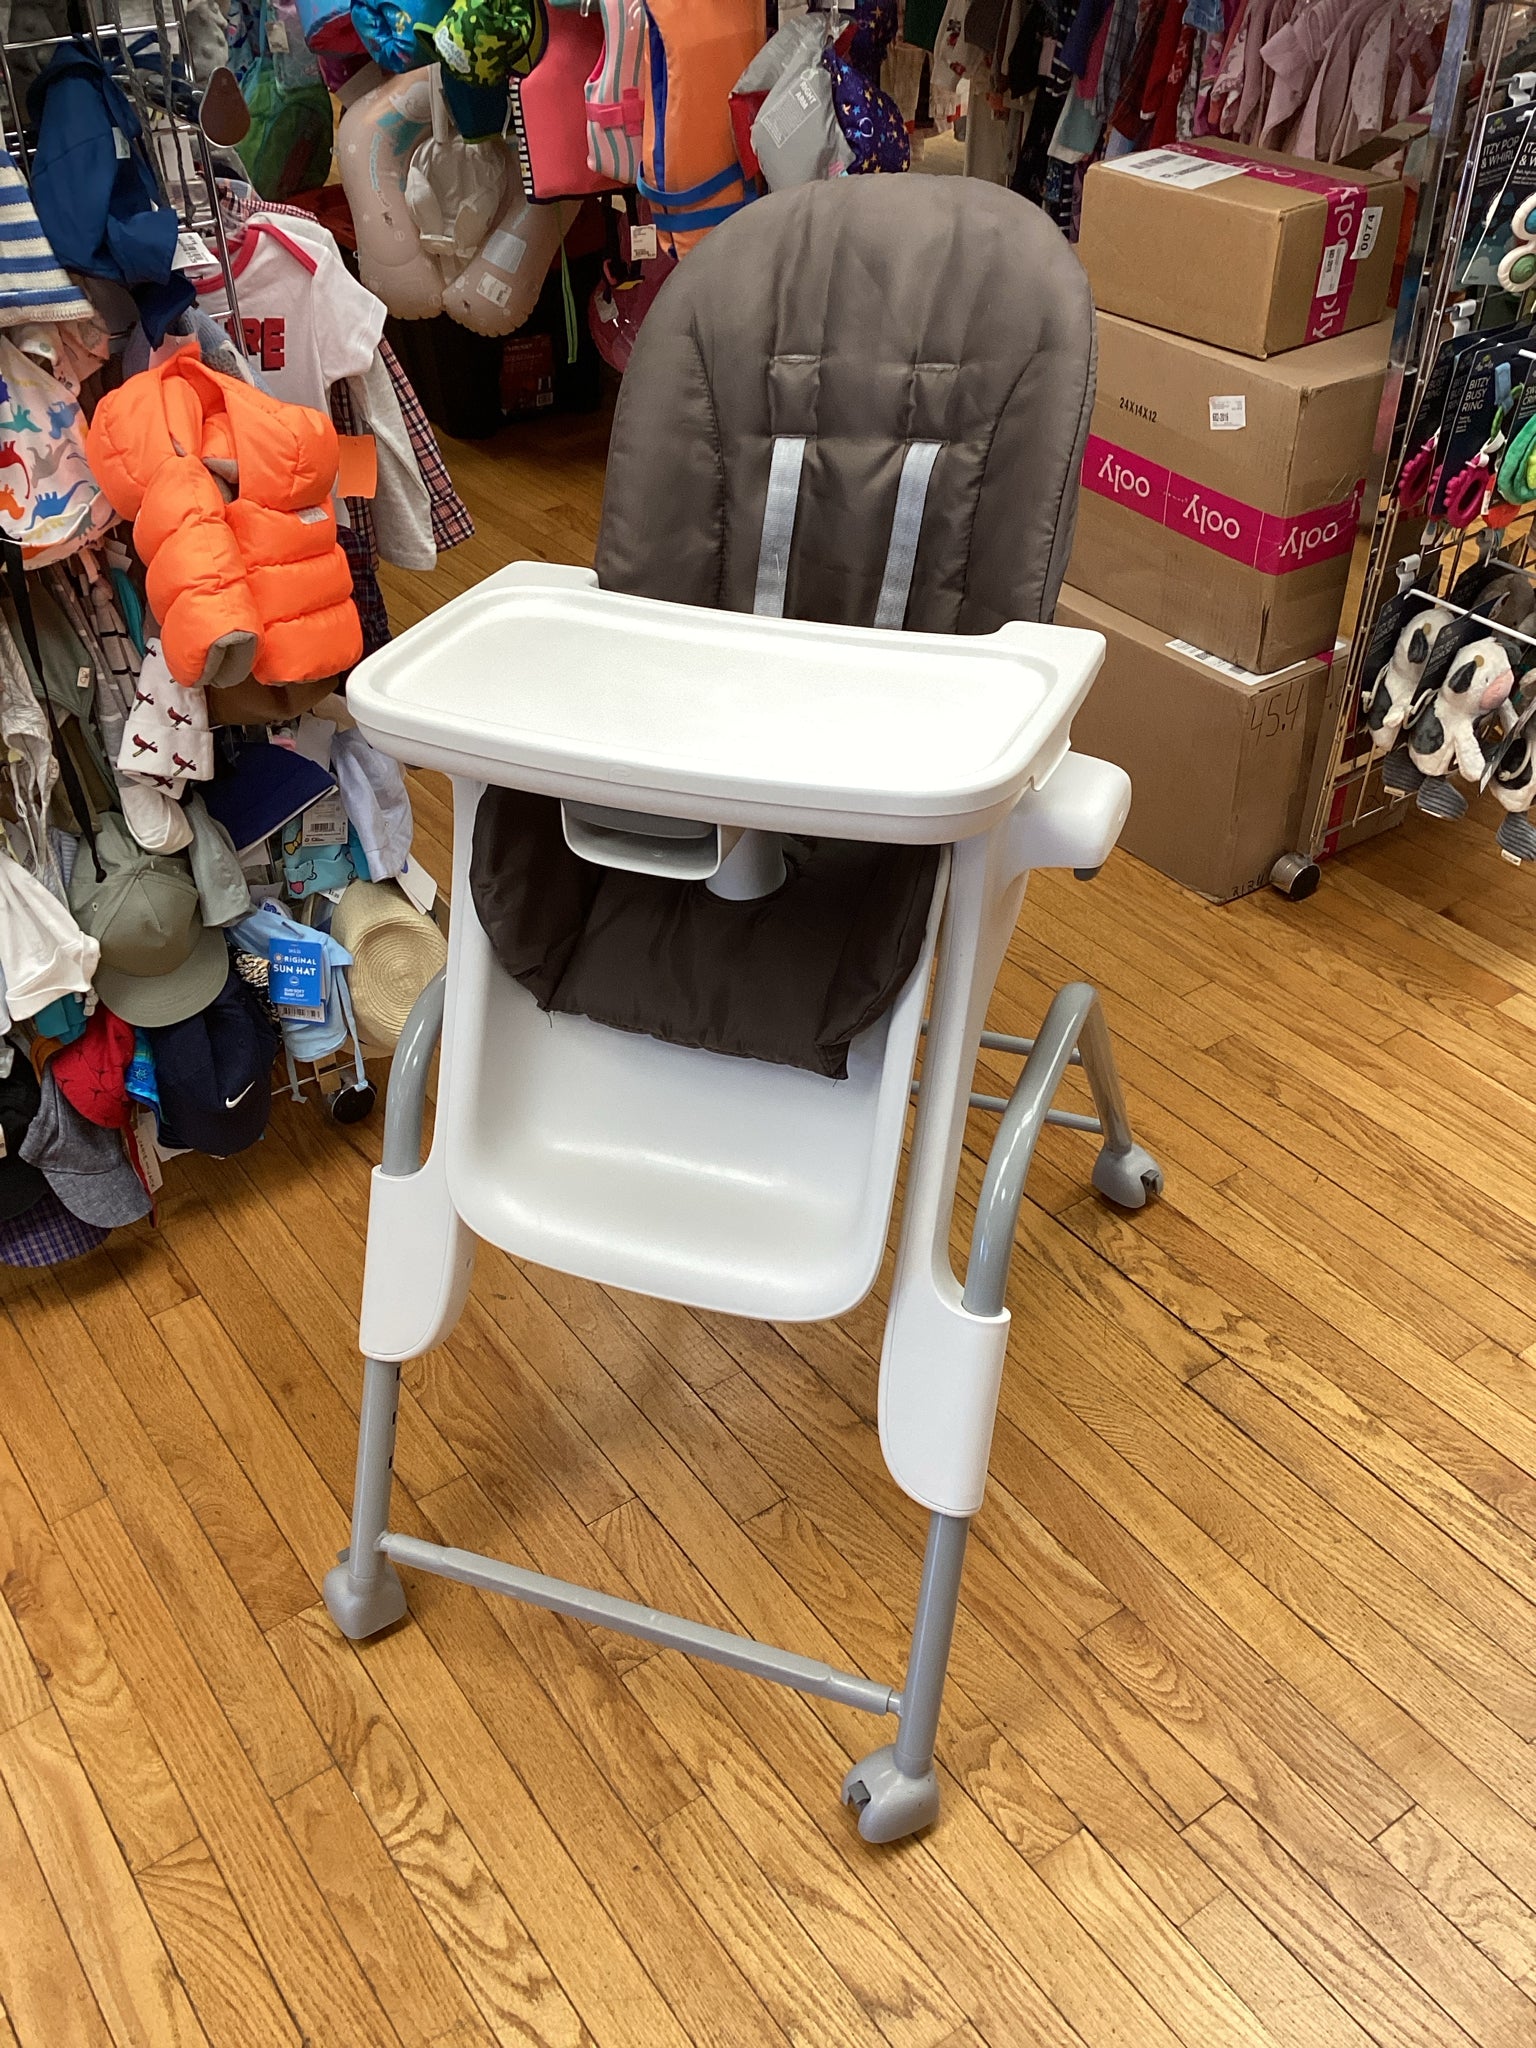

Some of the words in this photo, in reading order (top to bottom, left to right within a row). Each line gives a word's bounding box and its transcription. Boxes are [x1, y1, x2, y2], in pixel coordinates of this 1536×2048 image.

[800, 80, 817, 105] RIGHT
[1483, 141, 1501, 157] ITZY
[1501, 136, 1520, 151] POP
[1519, 154, 1527, 166] &
[1360, 213, 1375, 251] 0074
[1468, 376, 1492, 390] BITZY
[1465, 388, 1488, 401] BUSY
[1119, 397, 1157, 424] 24X14X12
[1461, 400, 1485, 412] RING
[1183, 493, 1241, 540] ooly
[1250, 681, 1305, 746] 45.4
[273, 963, 294, 974] SUN
[296, 966, 317, 977] HAT
